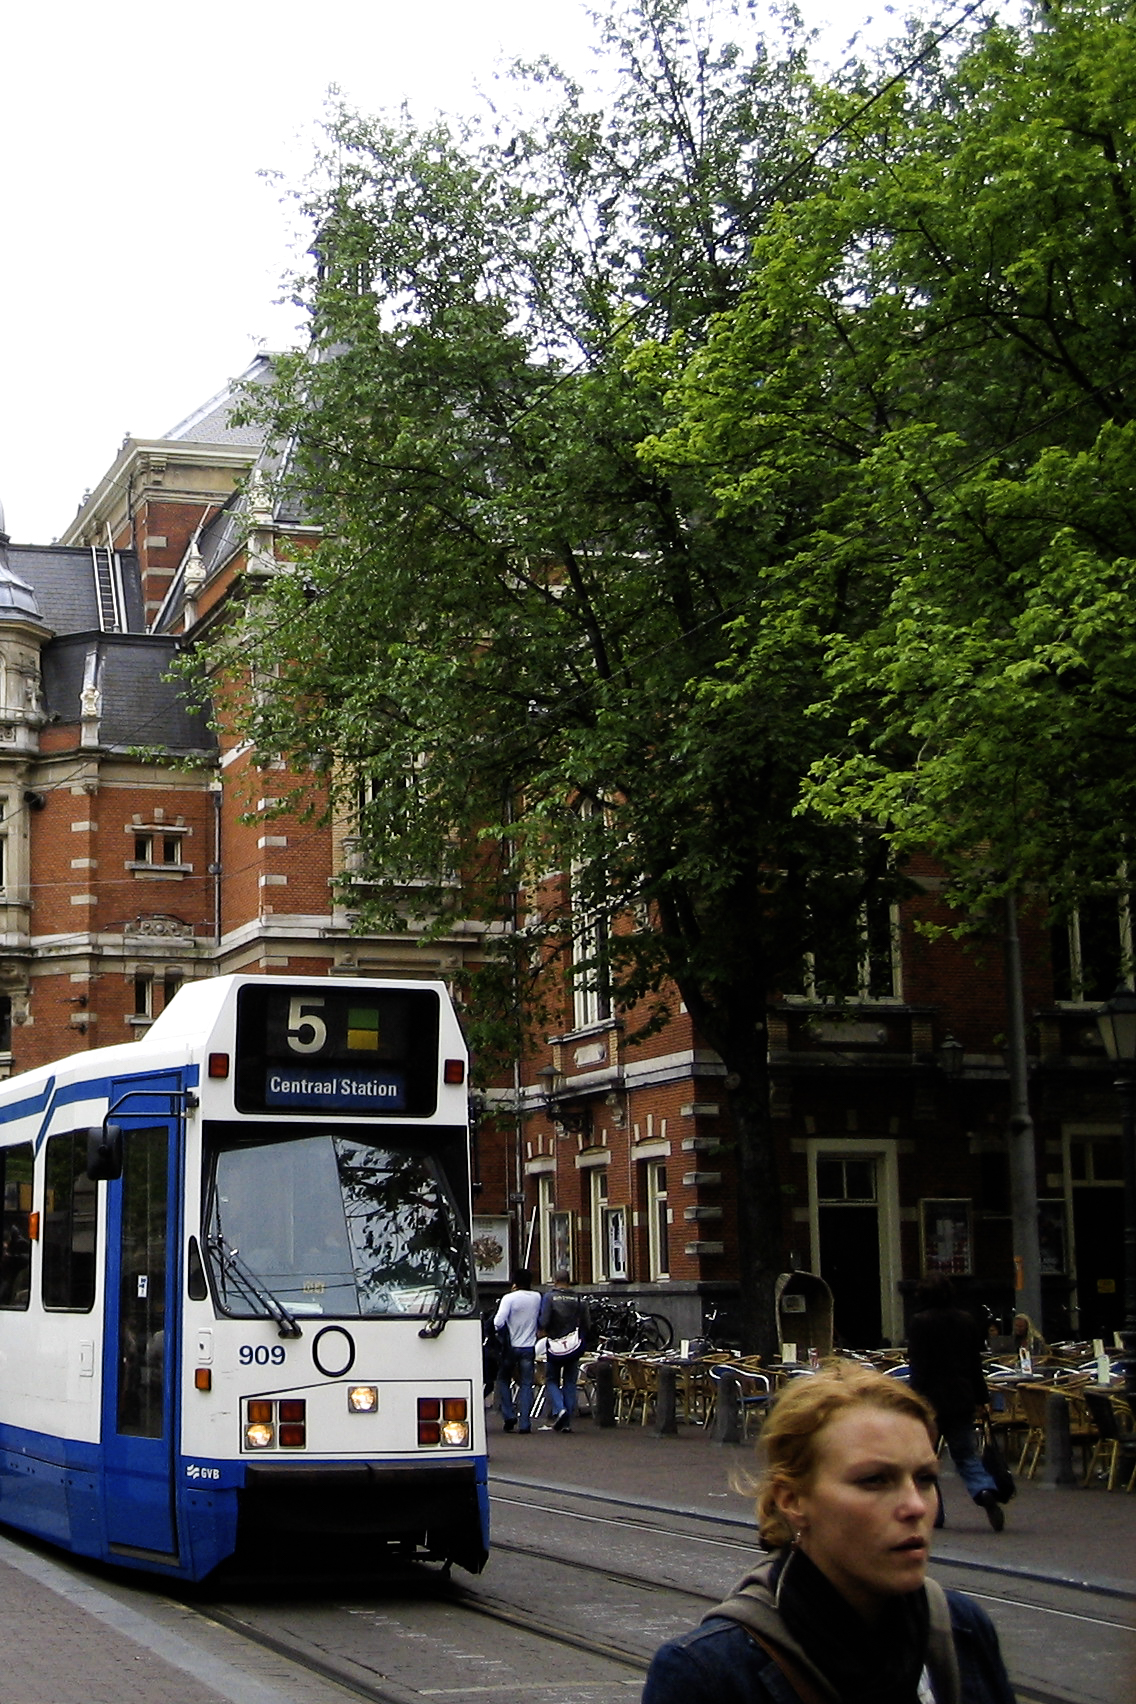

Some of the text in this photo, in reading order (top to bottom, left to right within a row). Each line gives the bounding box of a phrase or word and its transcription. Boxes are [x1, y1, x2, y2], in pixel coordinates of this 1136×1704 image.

[286, 997, 327, 1054] 5
[270, 1076, 397, 1097] Centraal Station
[239, 1345, 286, 1365] 909
[201, 1467, 220, 1480] GVB
